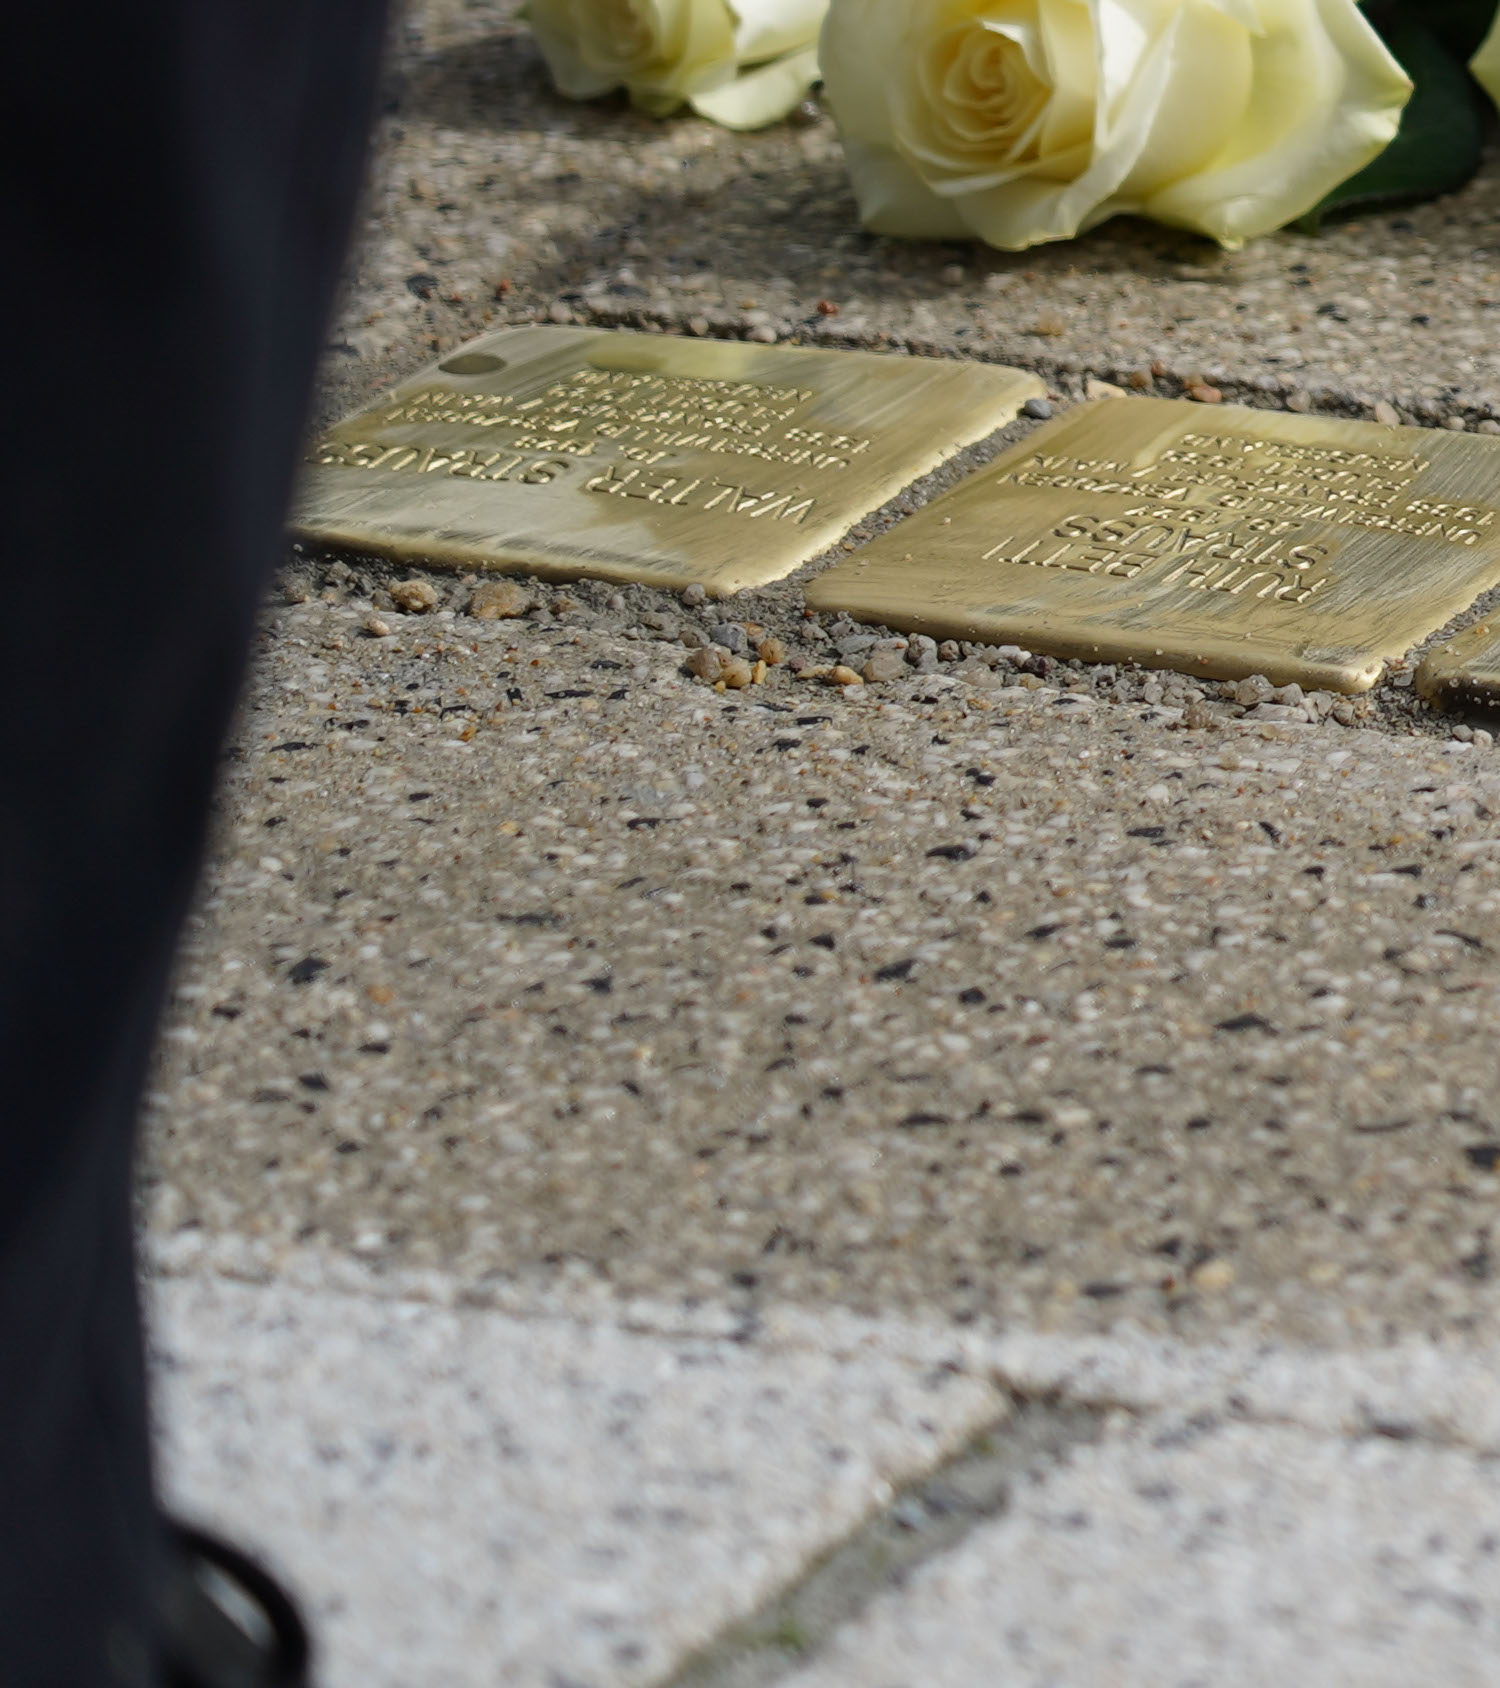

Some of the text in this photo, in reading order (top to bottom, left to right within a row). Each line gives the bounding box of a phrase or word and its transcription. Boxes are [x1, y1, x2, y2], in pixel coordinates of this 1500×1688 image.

[414, 389, 514, 410] MAIN
[548, 381, 795, 420] FLUCHT 1939
[573, 369, 812, 401] NEUSEELAND
[546, 399, 770, 436] FRANKFURT
[388, 409, 850, 468] UNFREIWILLIG VERZOGEN
[784, 427, 870, 453] 1938
[1183, 434, 1429, 473] NEUSEELAND
[1022, 452, 1132, 474] MAIN
[1161, 450, 1410, 491] FLUCHT 1939
[308, 443, 817, 523] WALTER STRAUSS
[1170, 469, 1397, 509] FRANKFURT
[997, 473, 1481, 544] UNFREIWILLIG VERZOGEN
[1123, 503, 1303, 535] JG. 1927
[1405, 499, 1494, 525] 1938
[1054, 515, 1327, 569] STRAUSS
[983, 537, 1327, 603] RUTH BETTI
